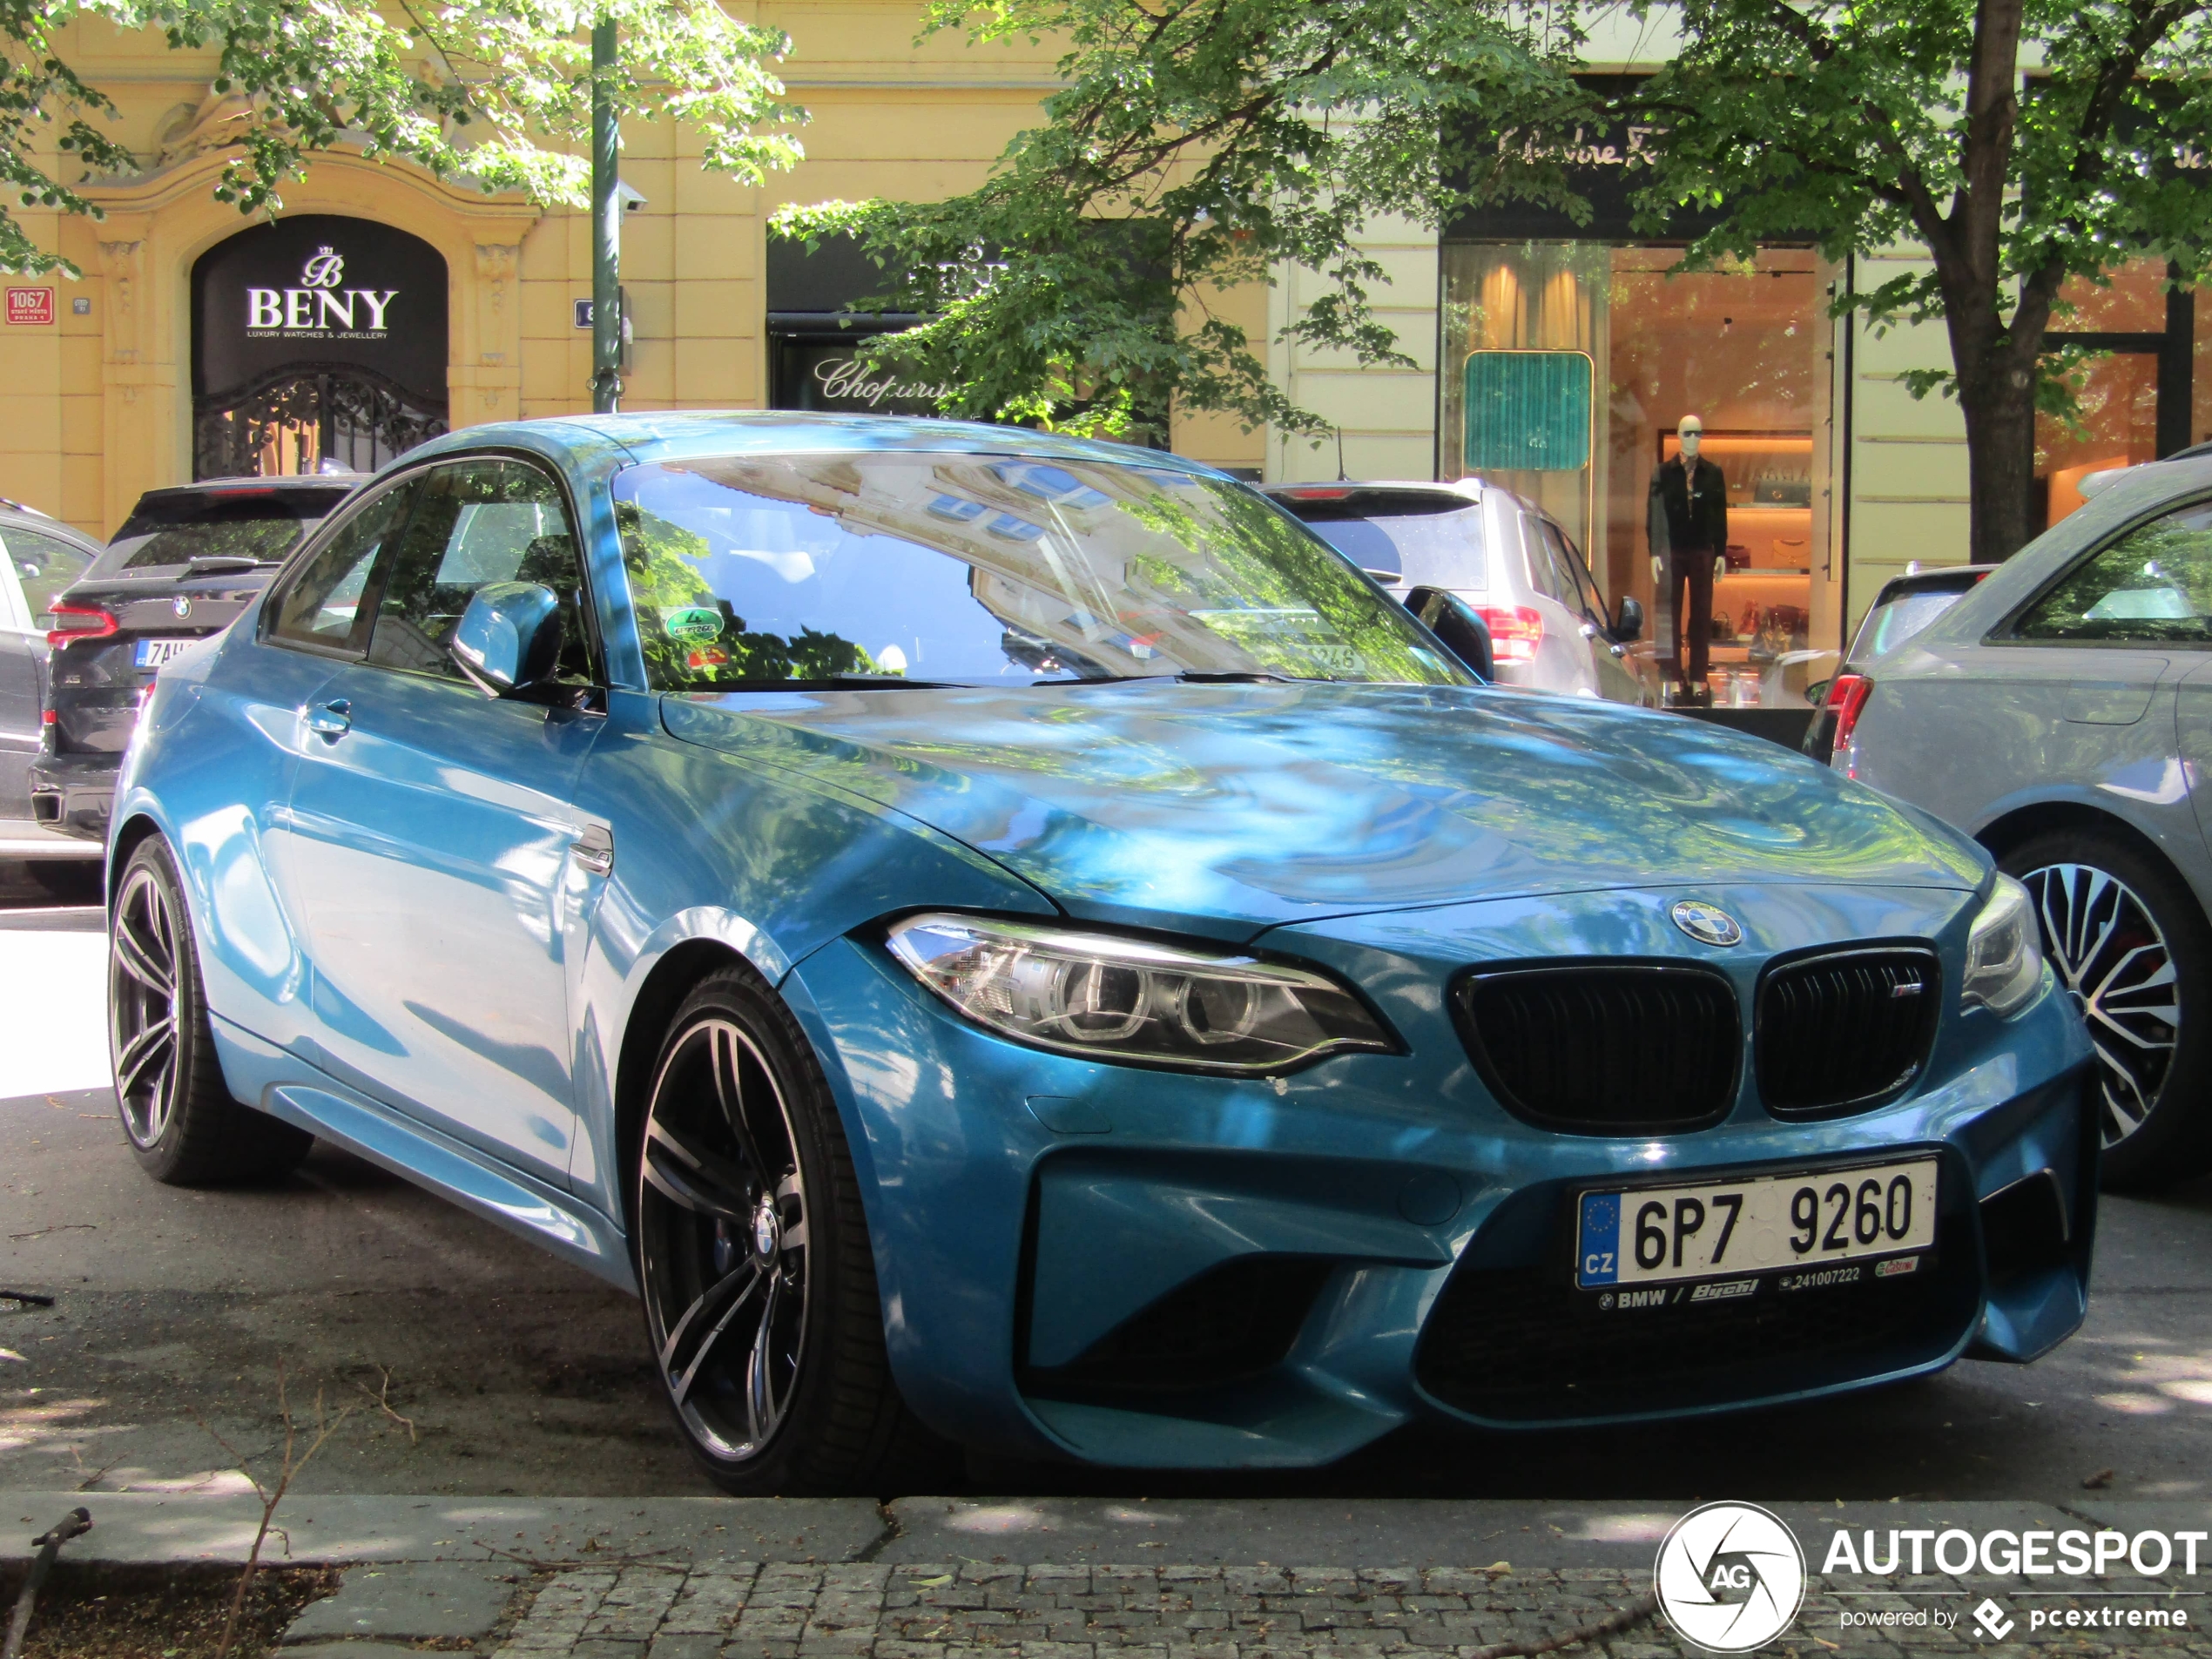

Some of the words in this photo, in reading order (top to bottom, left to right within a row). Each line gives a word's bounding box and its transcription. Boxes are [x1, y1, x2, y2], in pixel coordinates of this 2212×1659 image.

[301, 254, 345, 287] B
[10, 292, 45, 308] 1067
[247, 288, 400, 329] BENY
[337, 331, 388, 340] JEWELLERY
[1634, 1193, 1743, 1270] 6P7
[1790, 1174, 1912, 1254] 9260
[1585, 1253, 1613, 1274] CZ
[1884, 1260, 1913, 1274] Castrol
[1796, 1267, 1860, 1288] 241007222
[1617, 1289, 1666, 1309] BMW
